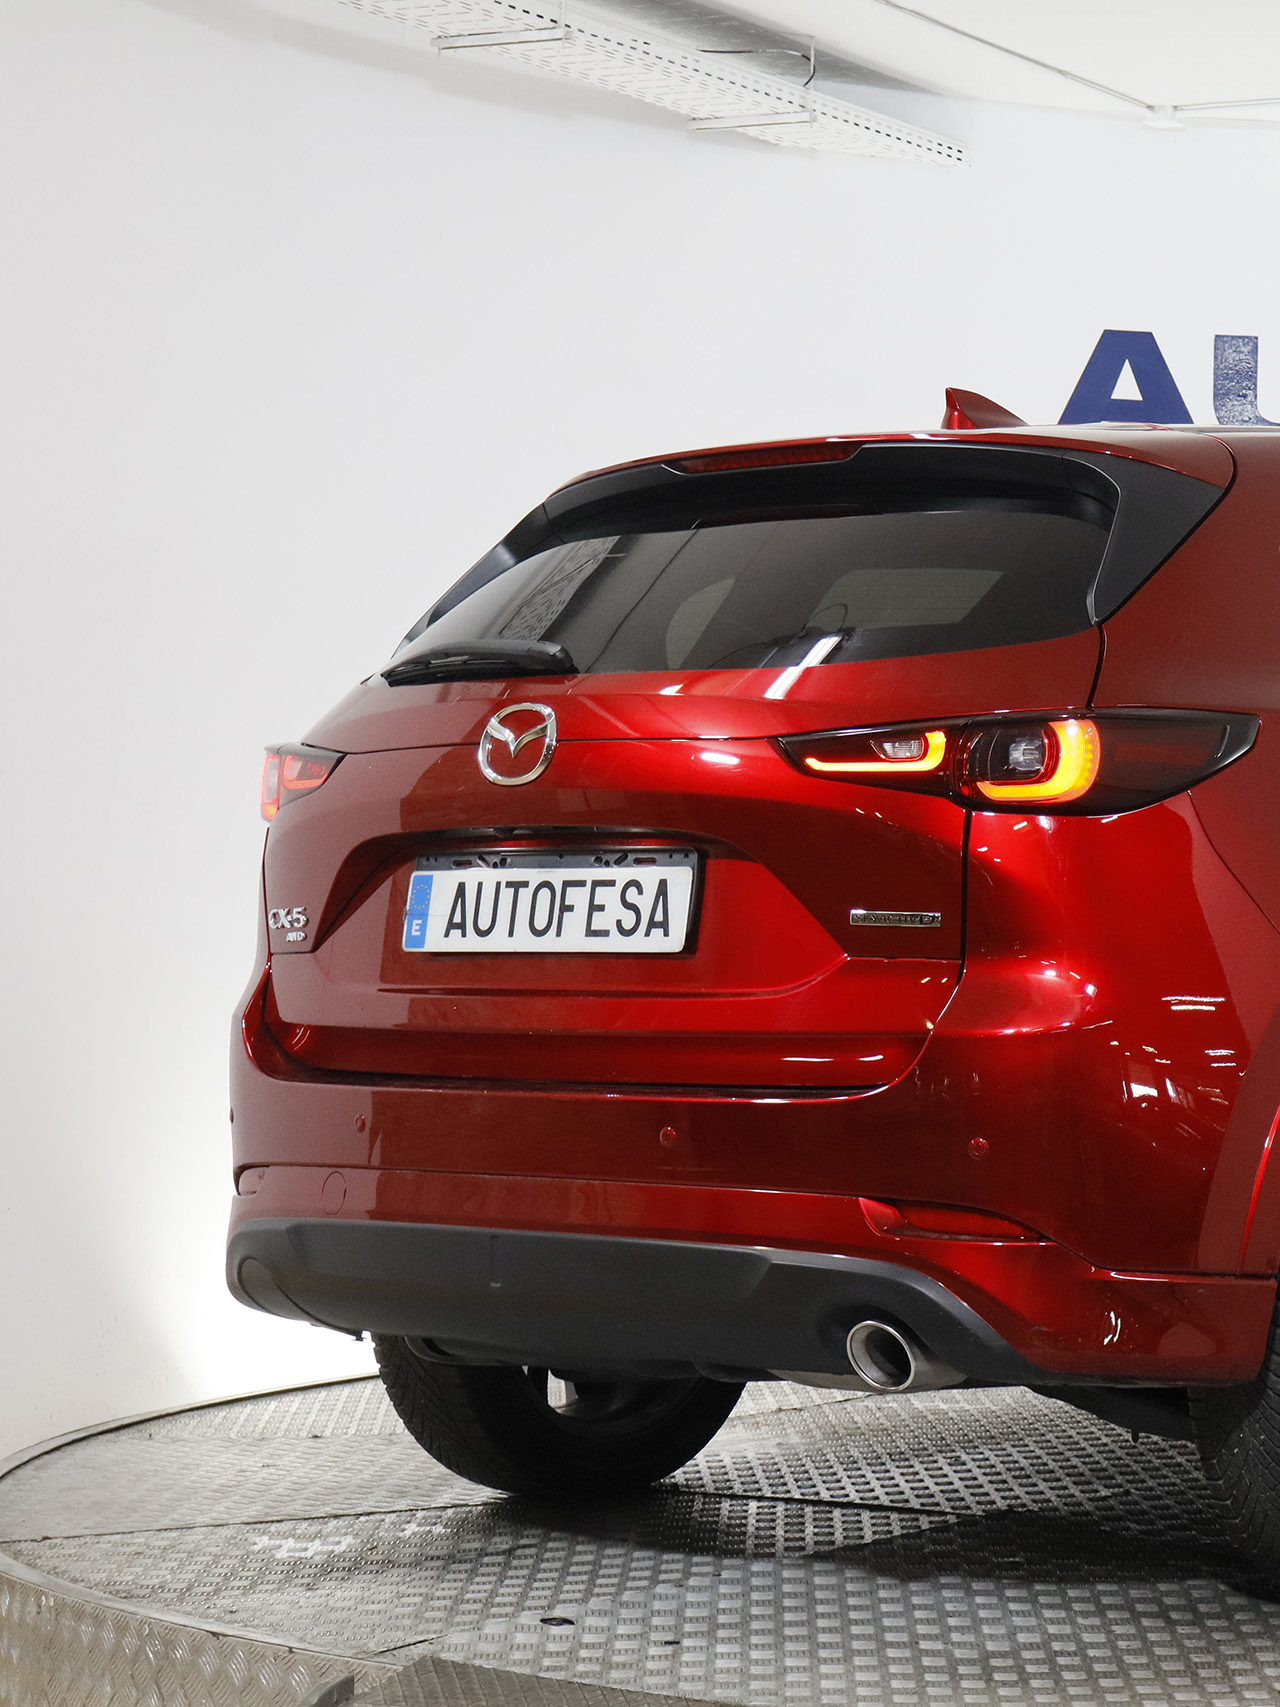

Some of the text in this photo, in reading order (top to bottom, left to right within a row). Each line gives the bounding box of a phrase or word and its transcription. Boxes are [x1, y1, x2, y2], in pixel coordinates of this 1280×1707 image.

[268, 907, 308, 929] CX-5
[443, 878, 670, 938] AUTOFESA
[411, 919, 423, 936] E
